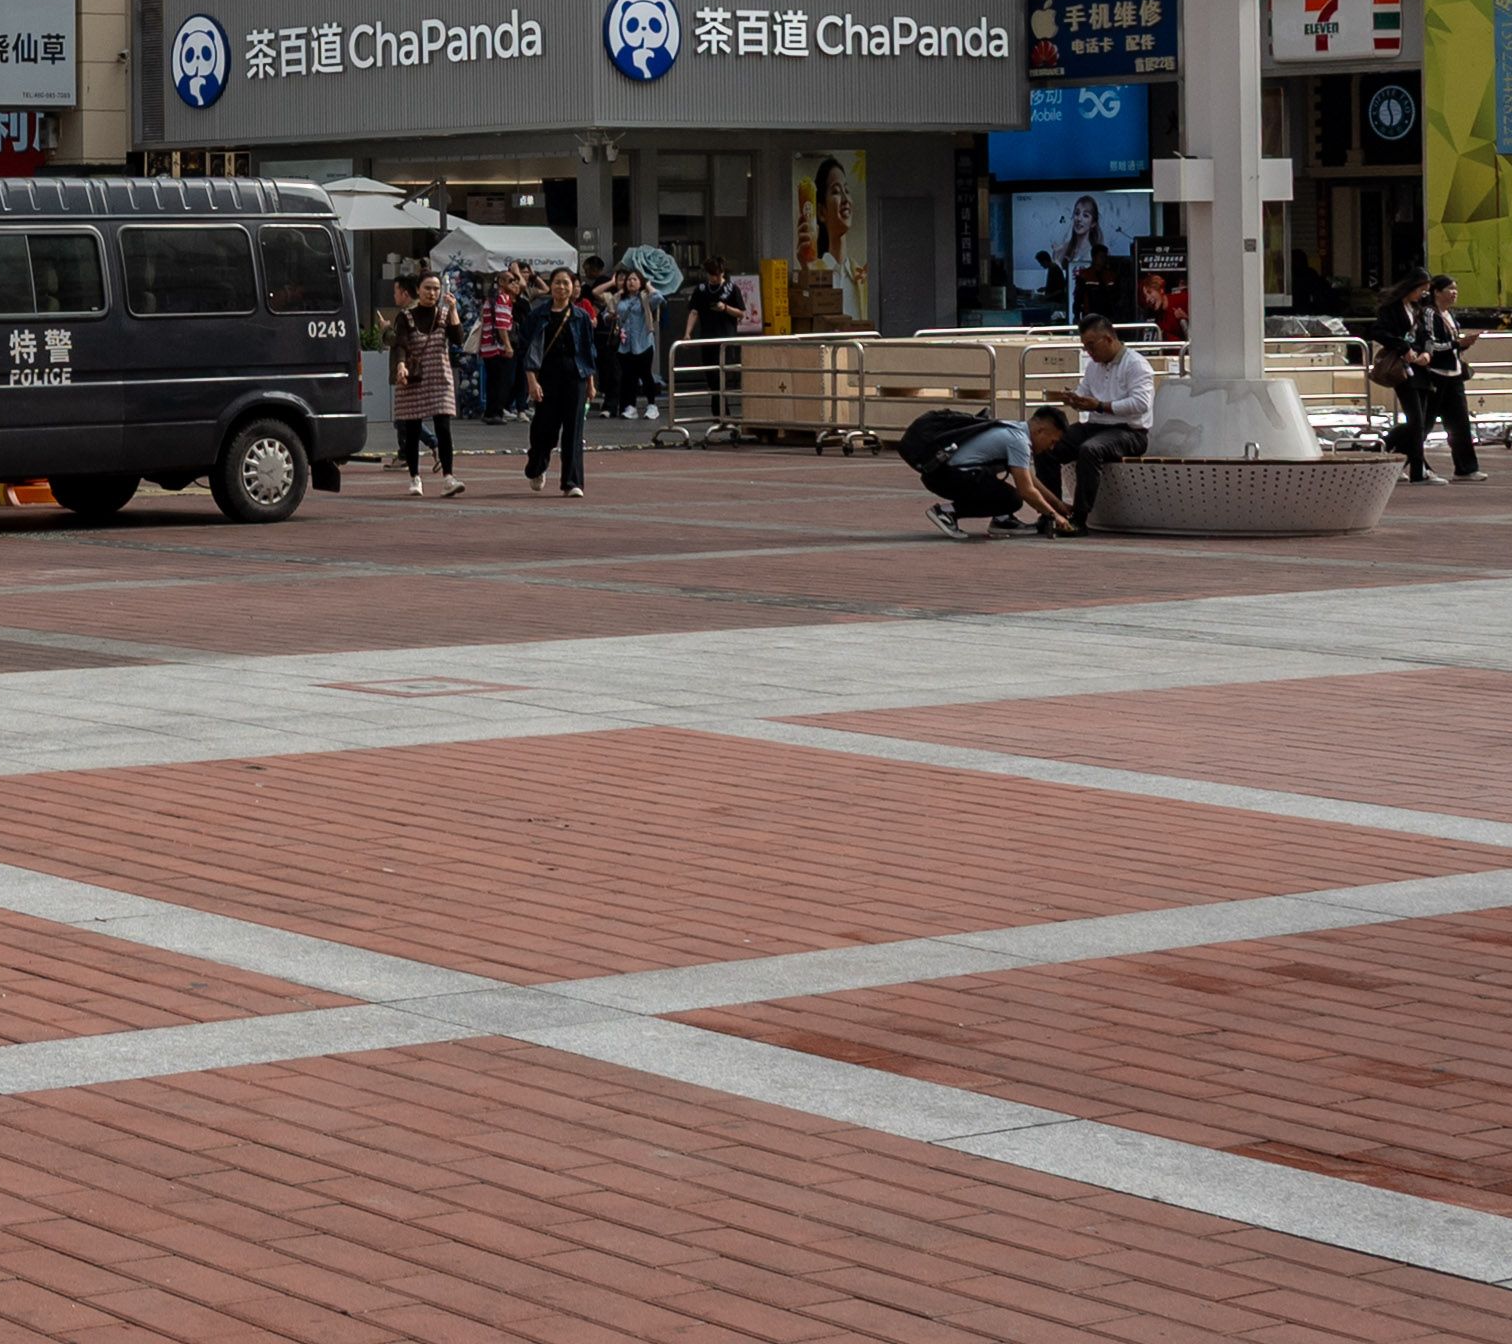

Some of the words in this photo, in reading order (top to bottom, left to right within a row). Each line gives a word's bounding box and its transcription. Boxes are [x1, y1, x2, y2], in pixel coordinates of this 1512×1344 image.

[1064, 0, 1163, 32] 手机维修
[245, 21, 343, 80] 茶百道
[348, 8, 542, 69] ChaPanda
[695, 7, 809, 58] 茶百道
[816, 14, 1010, 58] ChaPanda
[1071, 38, 1115, 55] 电话卡
[1124, 34, 1156, 53] 配件
[1078, 87, 1122, 119] 5G
[307, 319, 347, 339] 0243
[9, 329, 73, 365] 特警
[9, 367, 73, 386] POLICE
